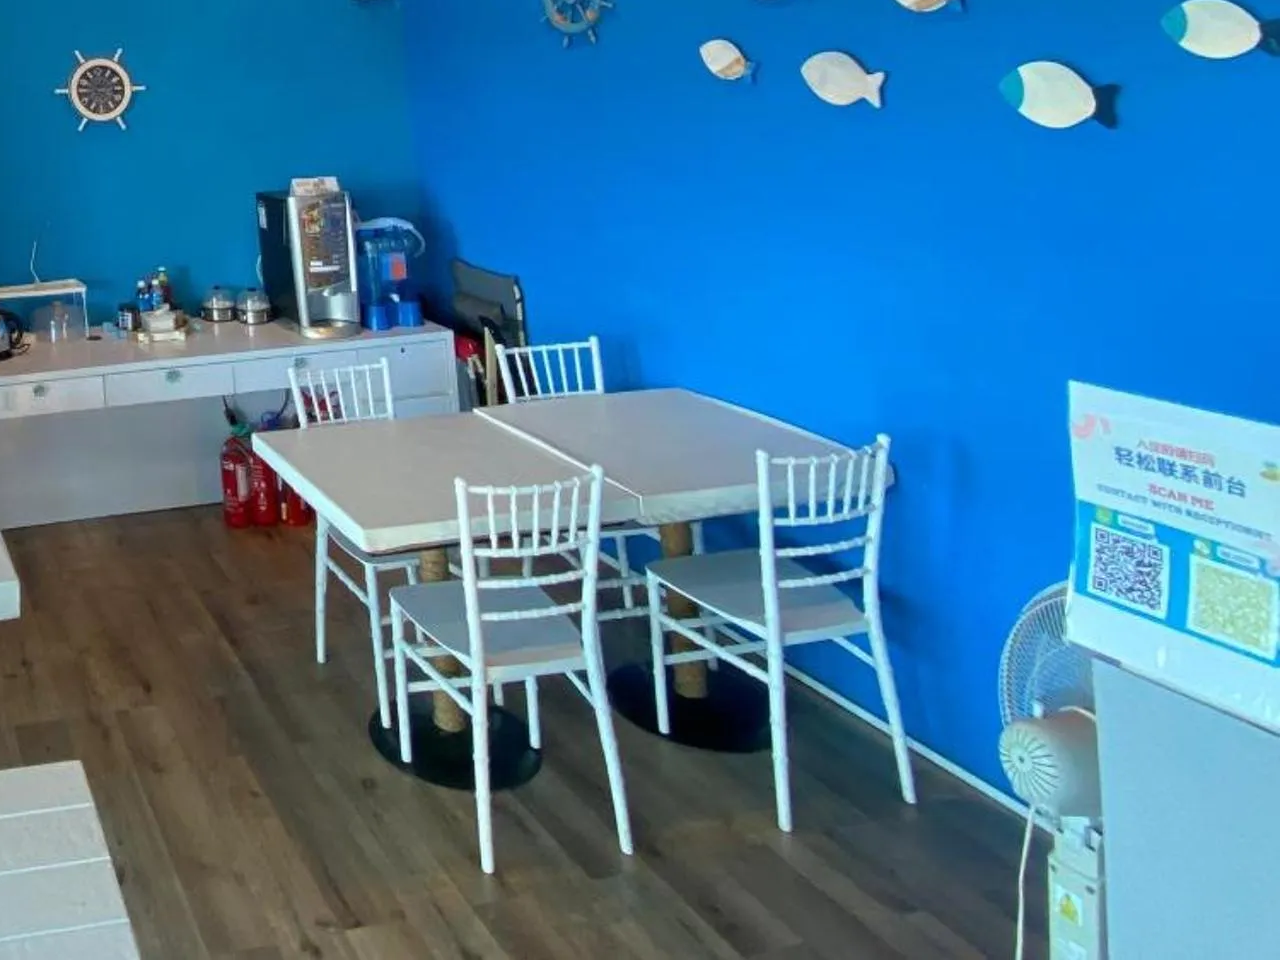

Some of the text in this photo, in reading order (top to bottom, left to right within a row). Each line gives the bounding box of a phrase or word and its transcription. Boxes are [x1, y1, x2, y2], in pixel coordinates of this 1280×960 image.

[1113, 445, 1247, 499] 轻松联系前台
[1148, 482, 1216, 512] SCAN ME
